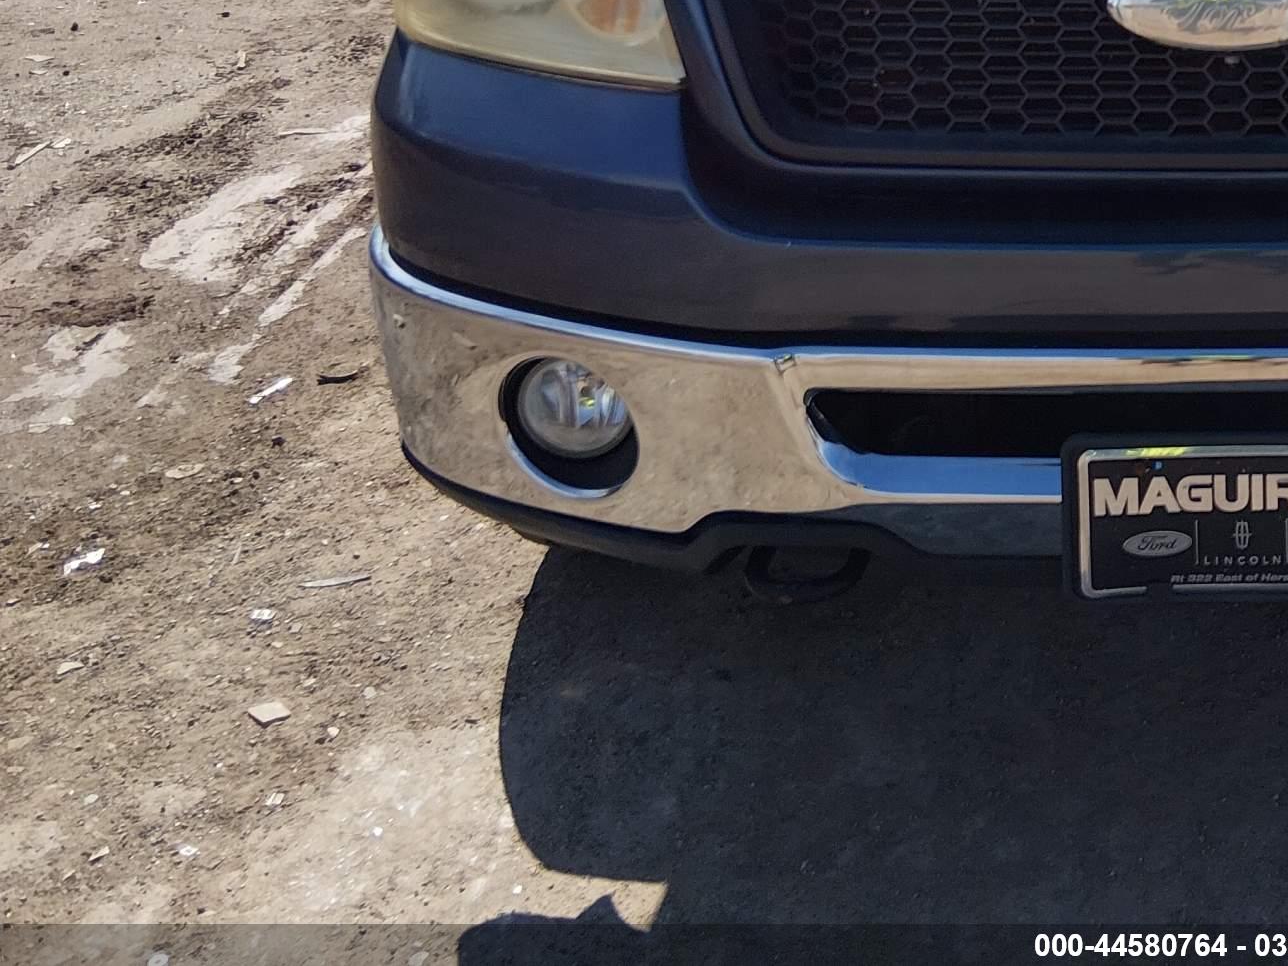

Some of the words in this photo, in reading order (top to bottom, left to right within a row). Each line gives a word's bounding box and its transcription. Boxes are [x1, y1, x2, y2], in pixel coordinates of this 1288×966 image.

[1137, 534, 1178, 552] Ford
[1203, 554, 1283, 566] LINCOLN
[1215, 573, 1243, 582] East
[1245, 573, 1259, 582] of
